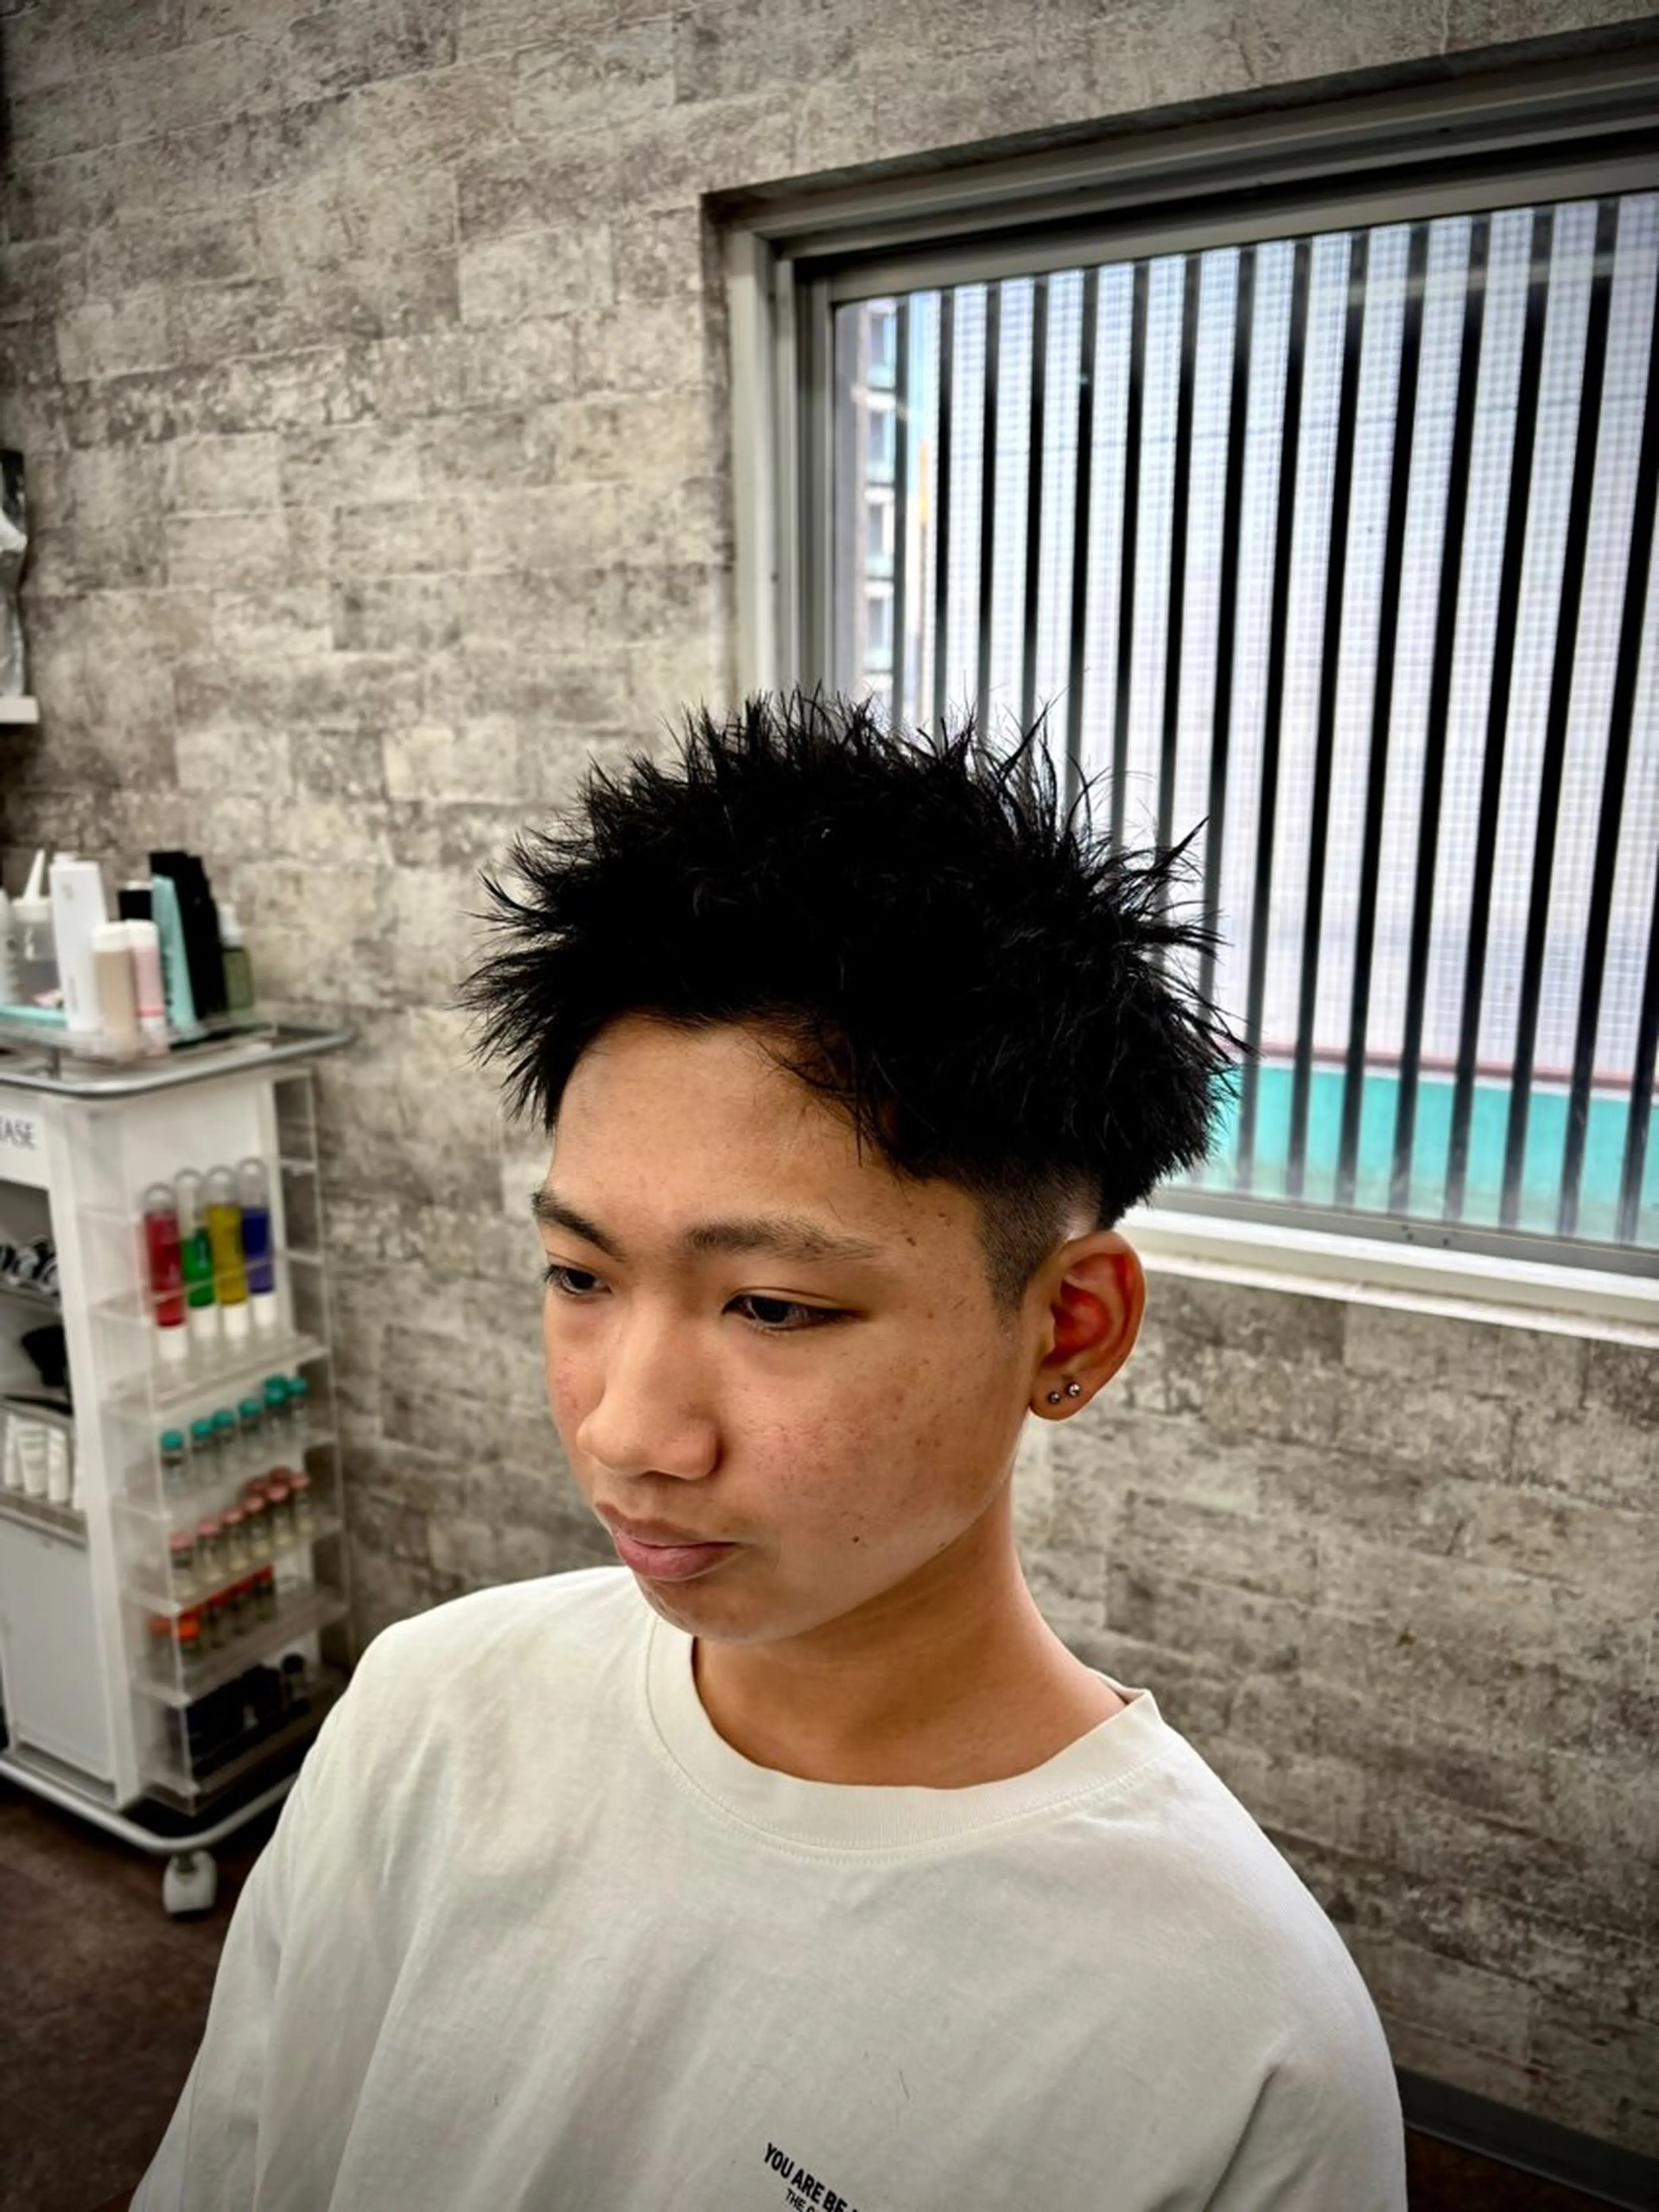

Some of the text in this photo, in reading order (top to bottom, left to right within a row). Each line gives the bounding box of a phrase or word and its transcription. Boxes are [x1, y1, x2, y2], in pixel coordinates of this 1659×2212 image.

[0, 1116, 36, 1151] ASE
[764, 2142, 858, 2212] YOU ARE BE
[785, 2188, 807, 2212] THE
